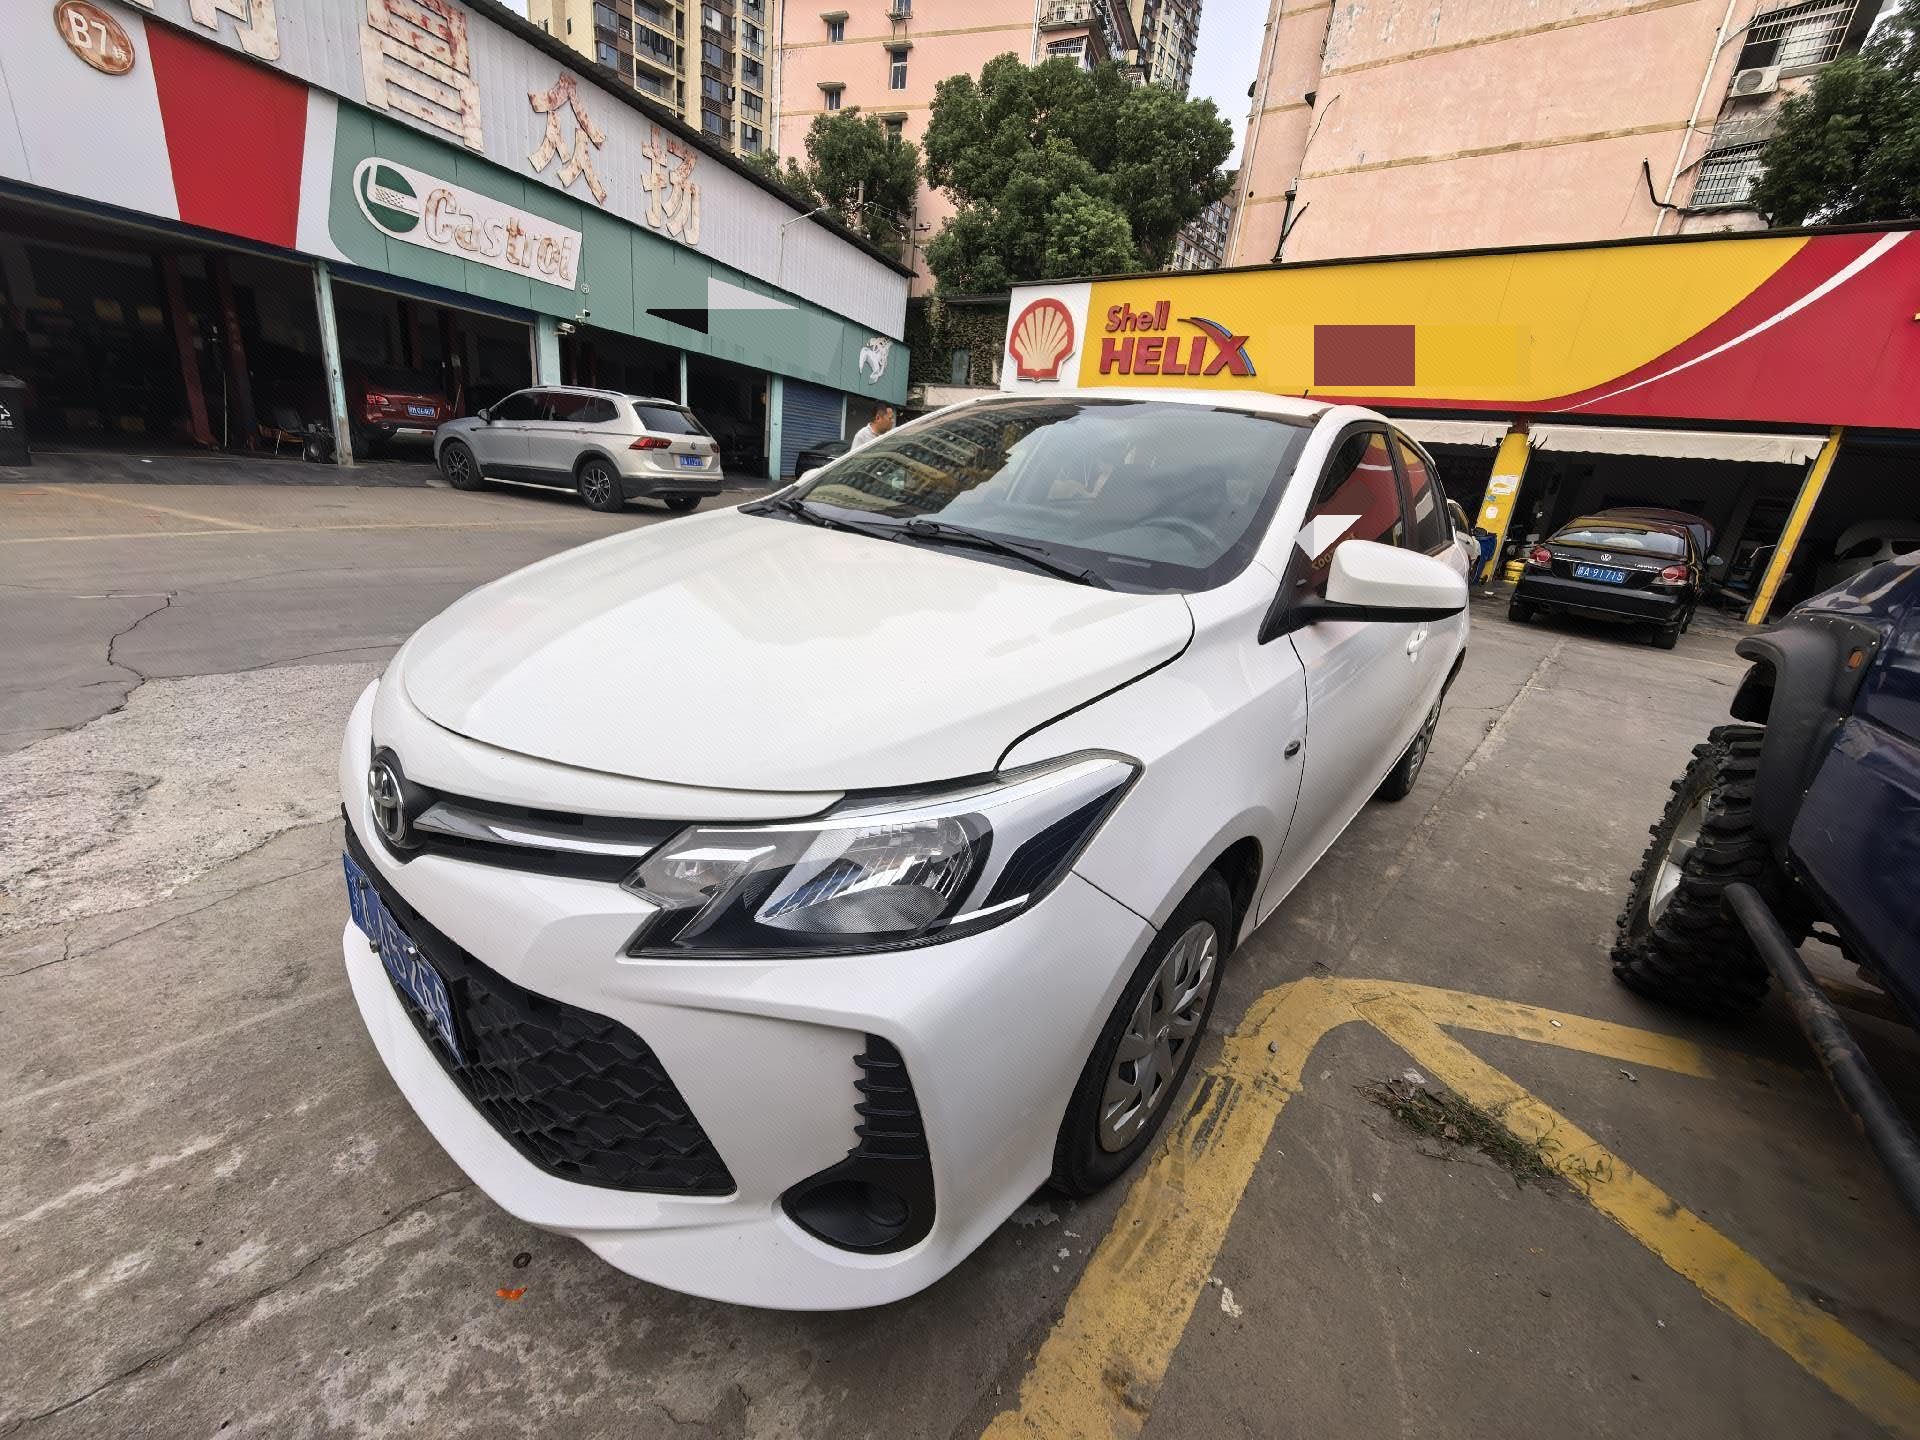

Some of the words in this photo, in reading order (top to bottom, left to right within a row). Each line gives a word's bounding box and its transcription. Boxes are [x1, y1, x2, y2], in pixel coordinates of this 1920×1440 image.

[424, 188, 573, 281] Castrol
[1105, 300, 1171, 332] Shell
[1099, 318, 1253, 376] HELIX
